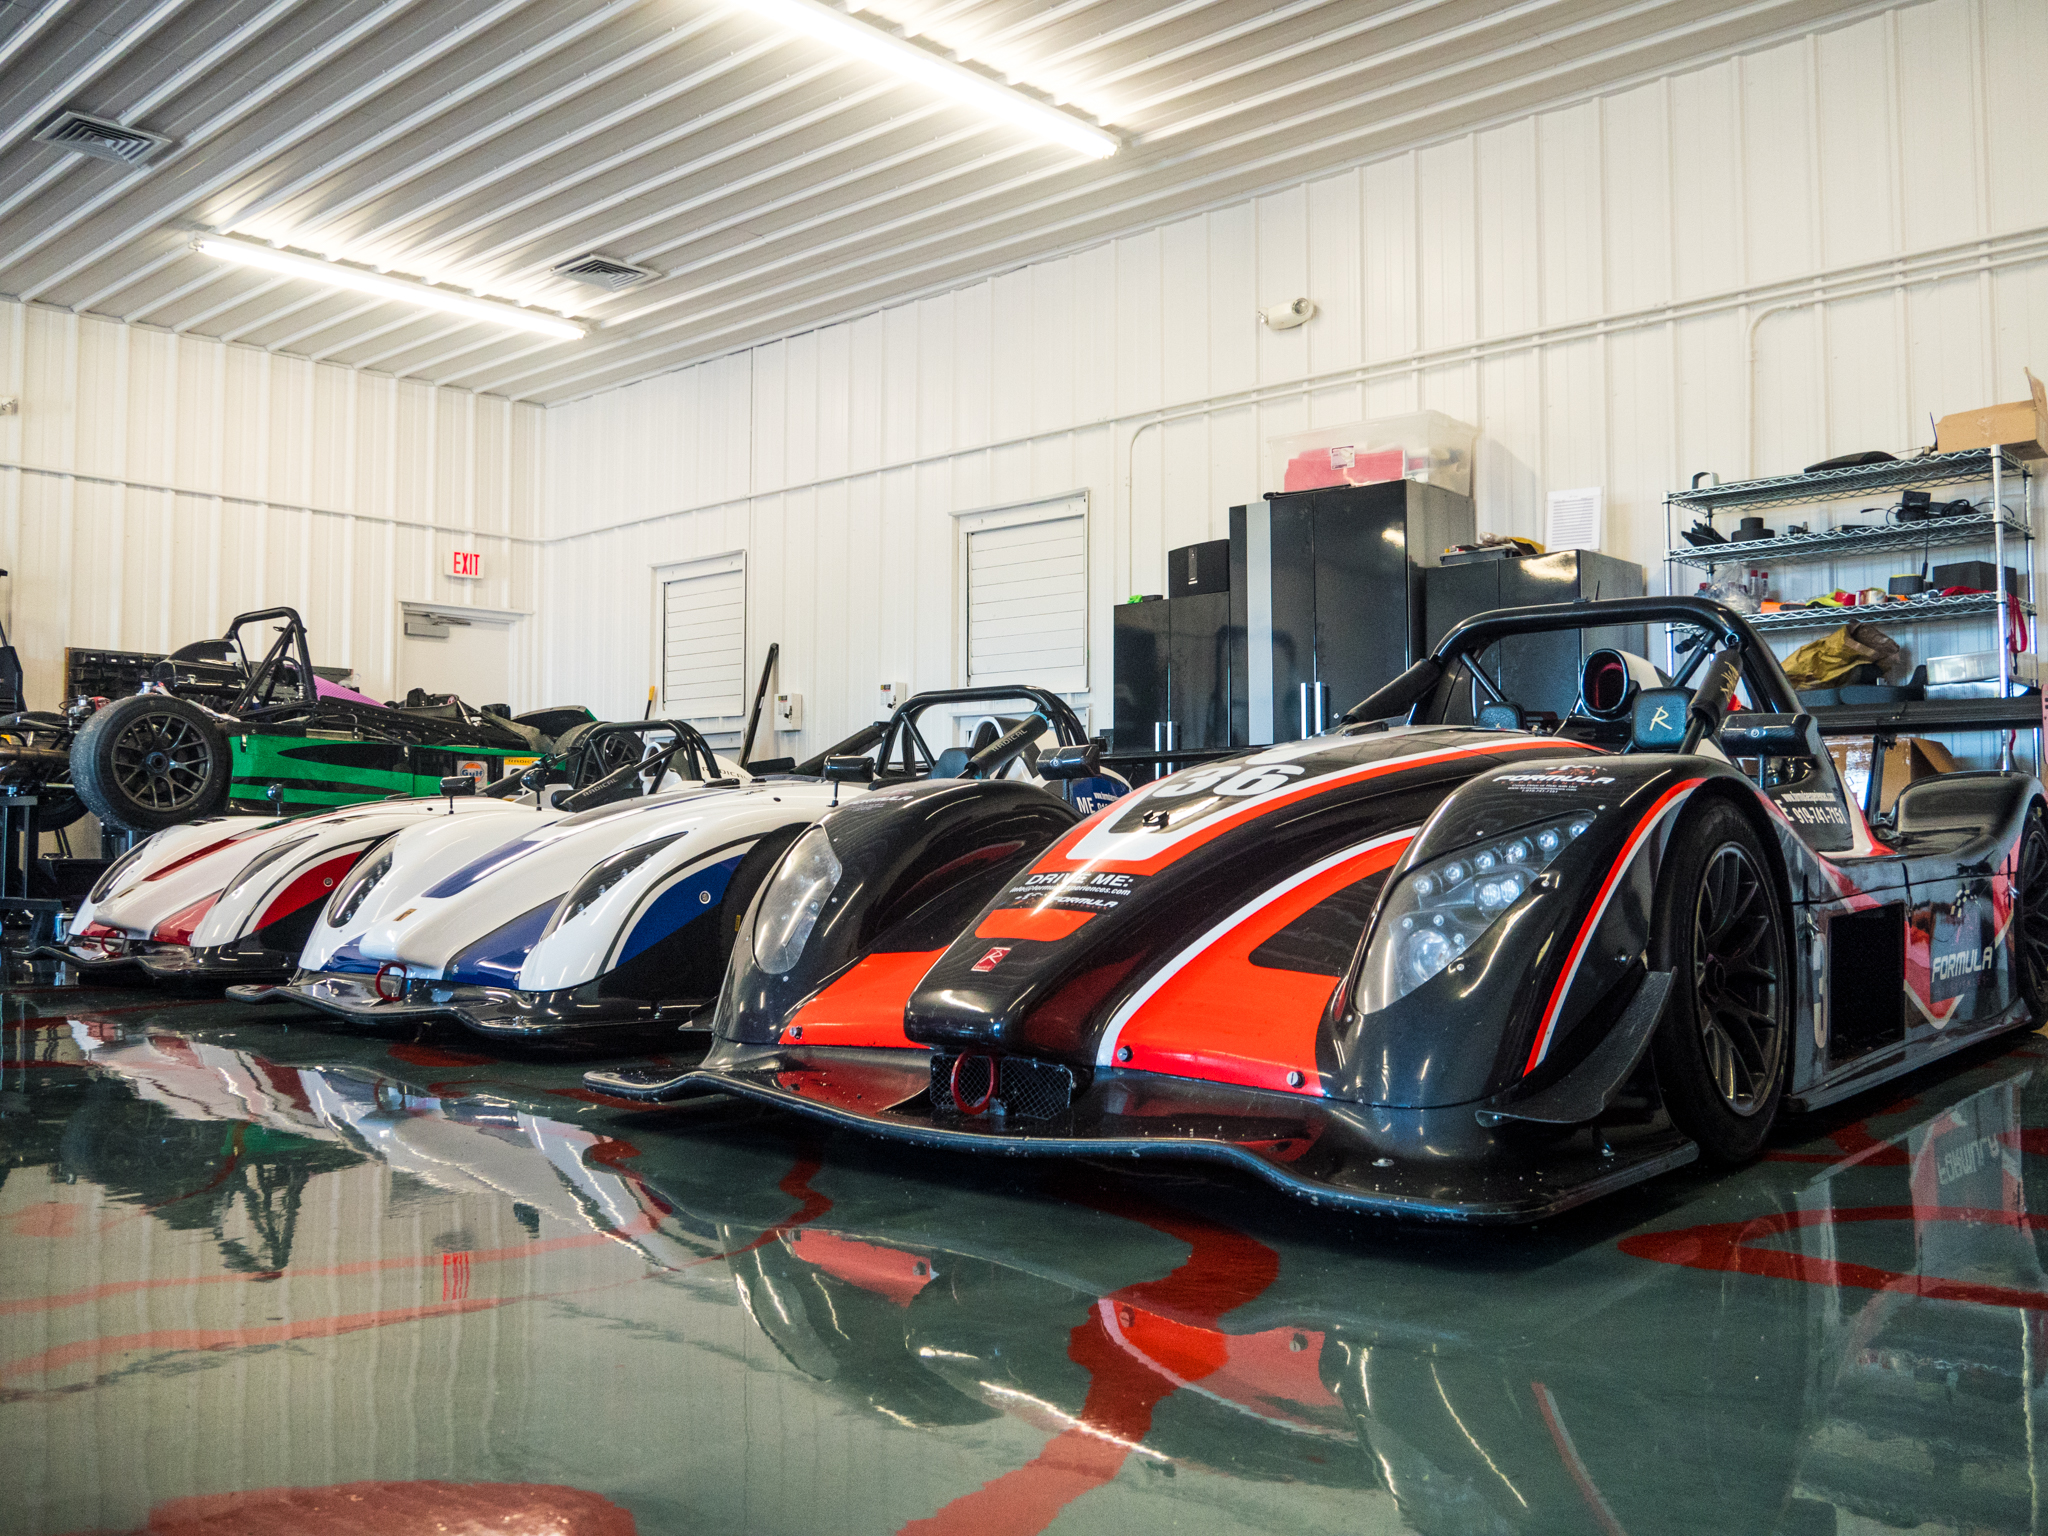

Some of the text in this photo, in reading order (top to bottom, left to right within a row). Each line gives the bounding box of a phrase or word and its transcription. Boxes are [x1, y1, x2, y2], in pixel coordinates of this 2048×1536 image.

[453, 551, 480, 576] EXIT
[1649, 705, 1673, 731] R
[461, 769, 483, 778] Gulf
[1152, 764, 1305, 797] 36
[1492, 774, 1616, 784] FORMULA
[582, 778, 618, 797] RADICAL
[1076, 796, 1096, 814] ME
[1792, 806, 1847, 824] 919-741-7151
[1025, 873, 1134, 887] DRIVE ME:
[1931, 946, 1994, 983] FORMULA
